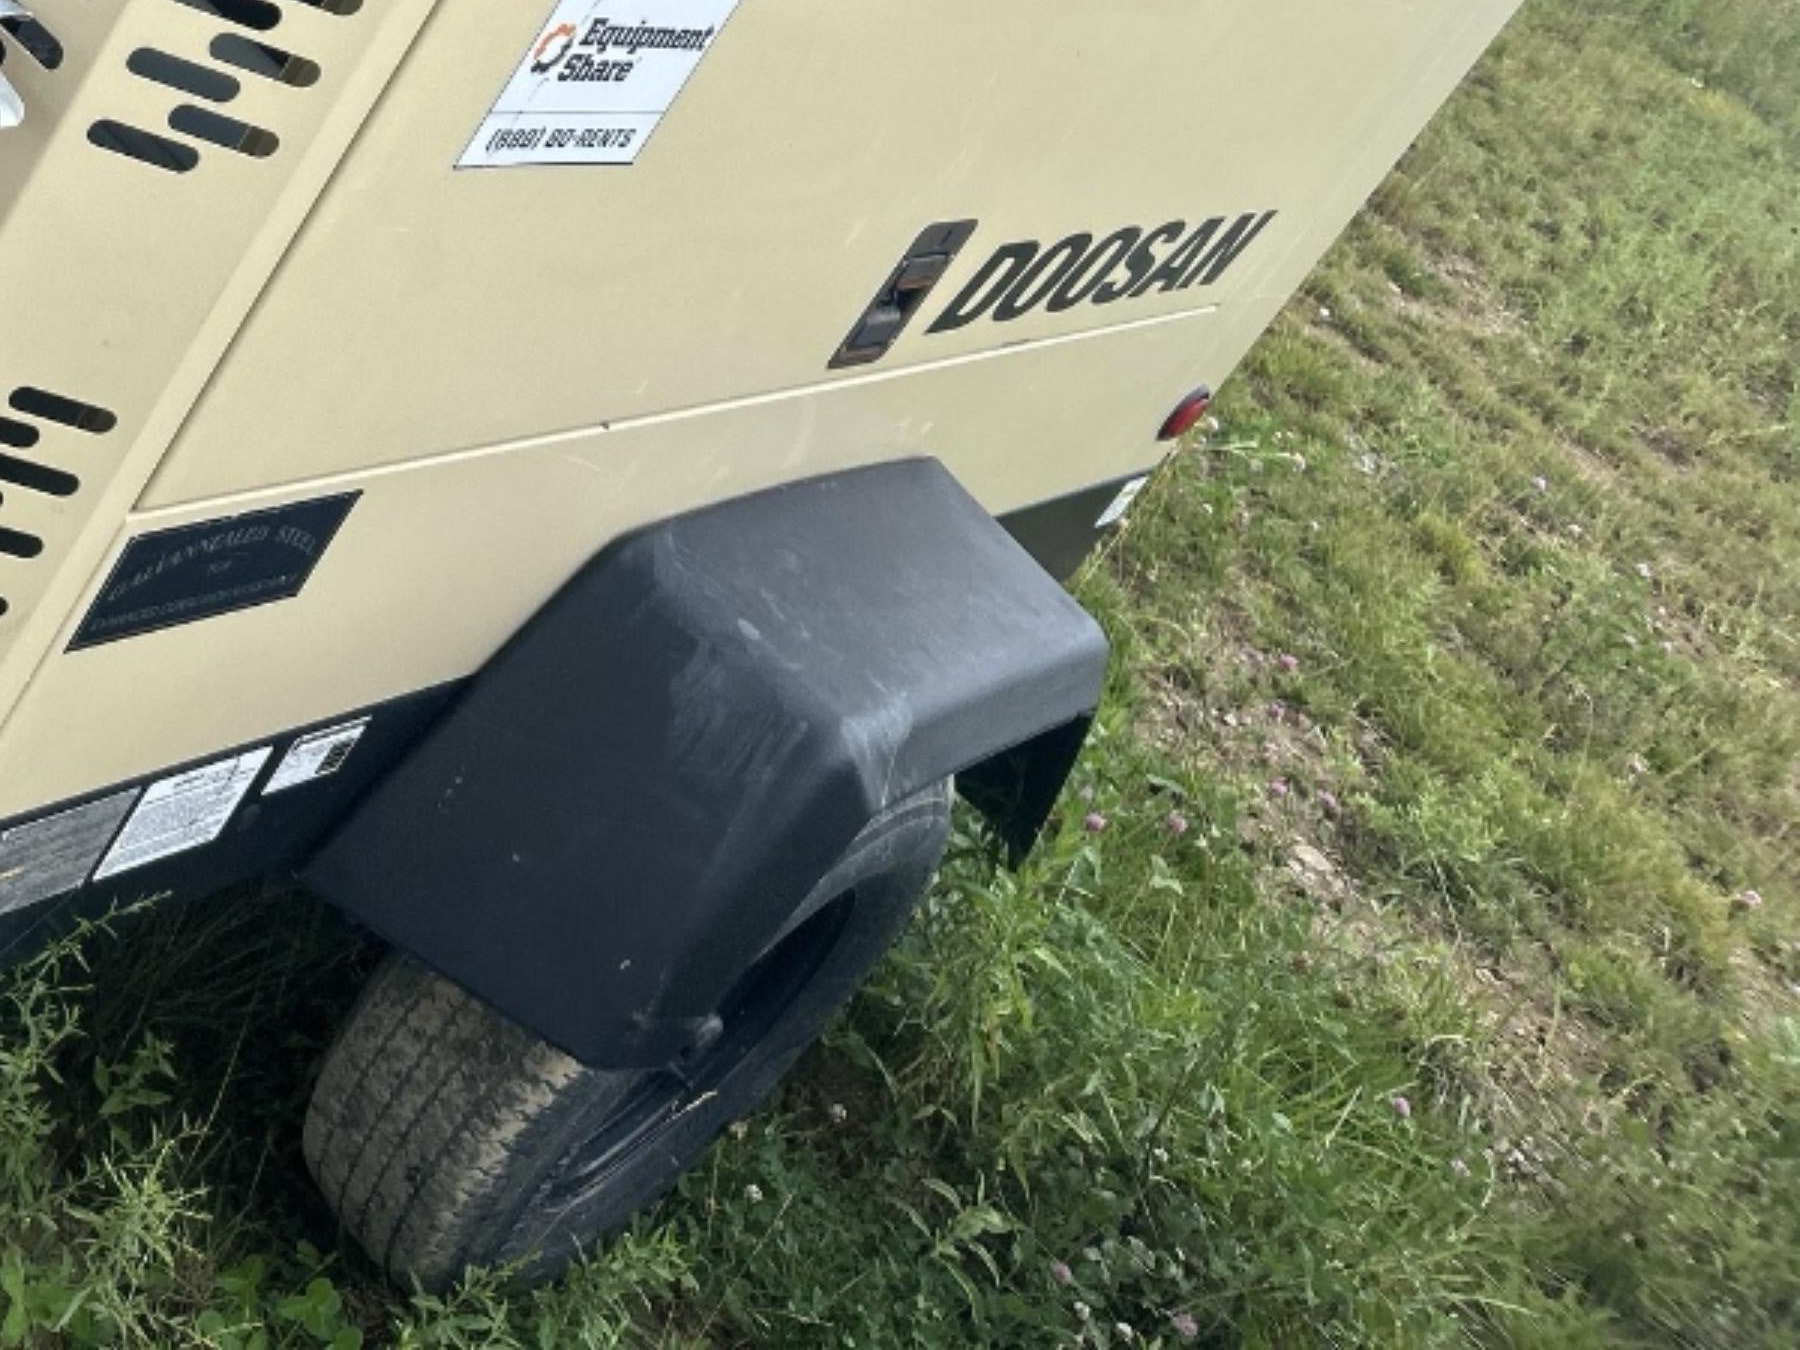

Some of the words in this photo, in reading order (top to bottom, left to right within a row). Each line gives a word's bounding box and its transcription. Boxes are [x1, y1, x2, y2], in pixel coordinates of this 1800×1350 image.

[579, 17, 715, 53] Equipment
[557, 53, 634, 82] Share
[485, 126, 546, 152] (888)
[924, 209, 1279, 335] DOOSAN
